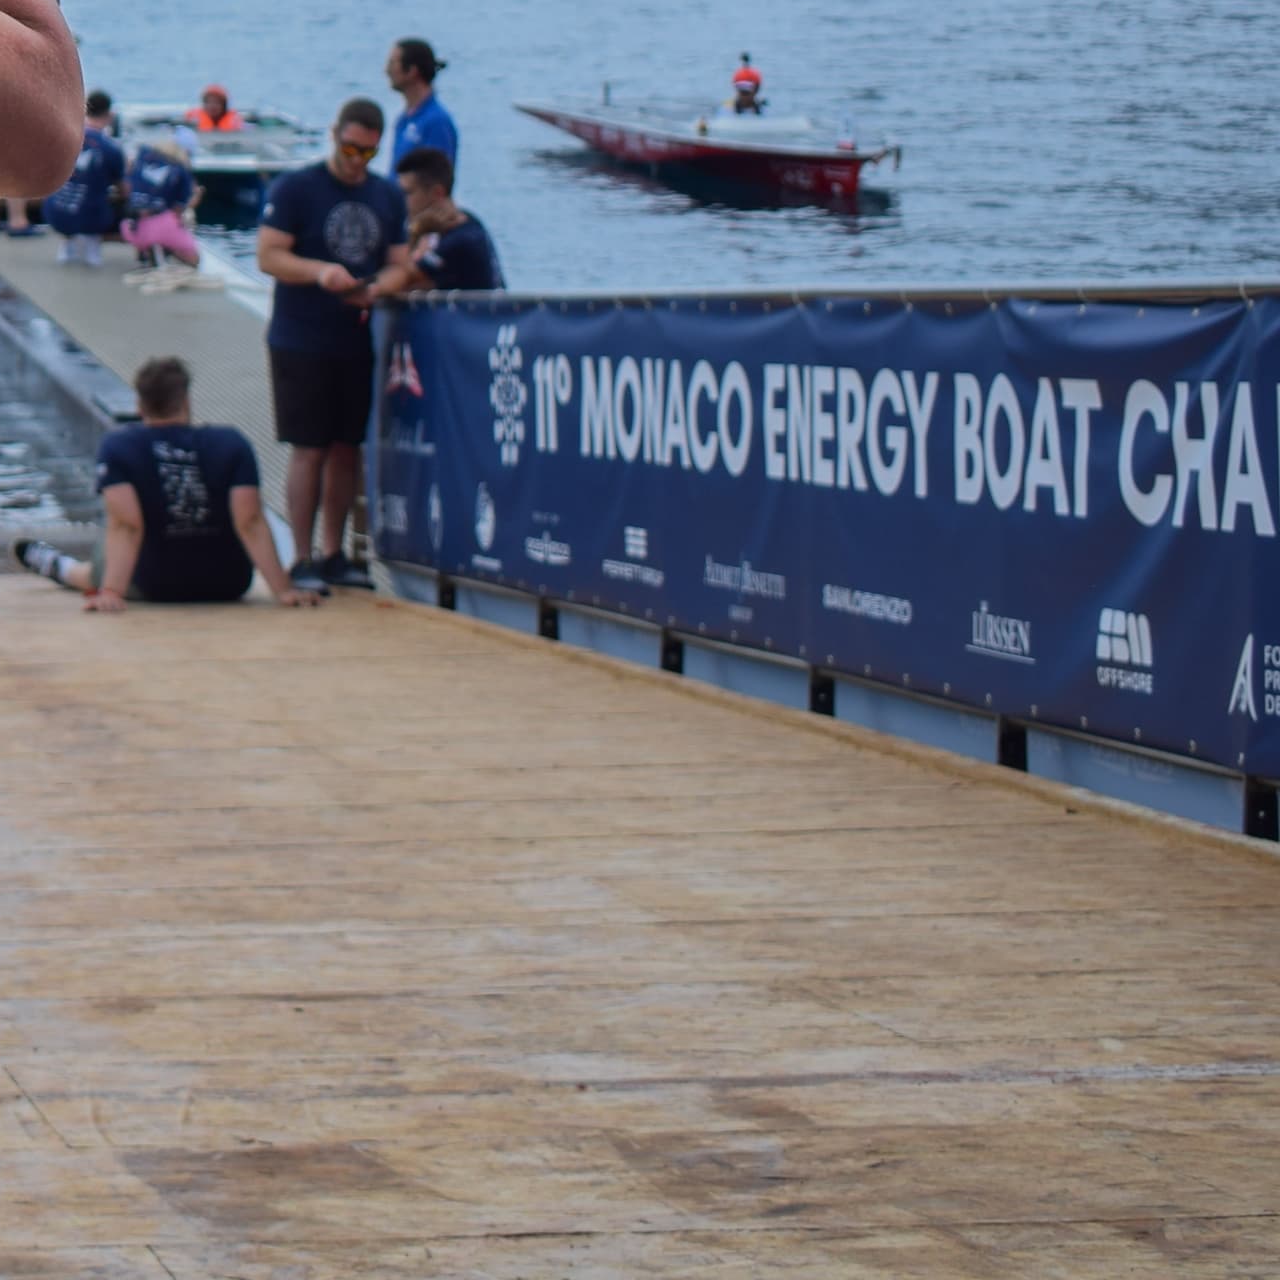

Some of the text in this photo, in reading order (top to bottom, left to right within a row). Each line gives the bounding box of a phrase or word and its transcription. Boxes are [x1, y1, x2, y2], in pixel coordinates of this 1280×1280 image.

[580, 355, 752, 477] MONACO
[764, 363, 939, 499] ENERGY
[954, 372, 1103, 518] BOAT
[1119, 378, 1280, 537] CHA
[1096, 665, 1154, 695] OFFSHORE
